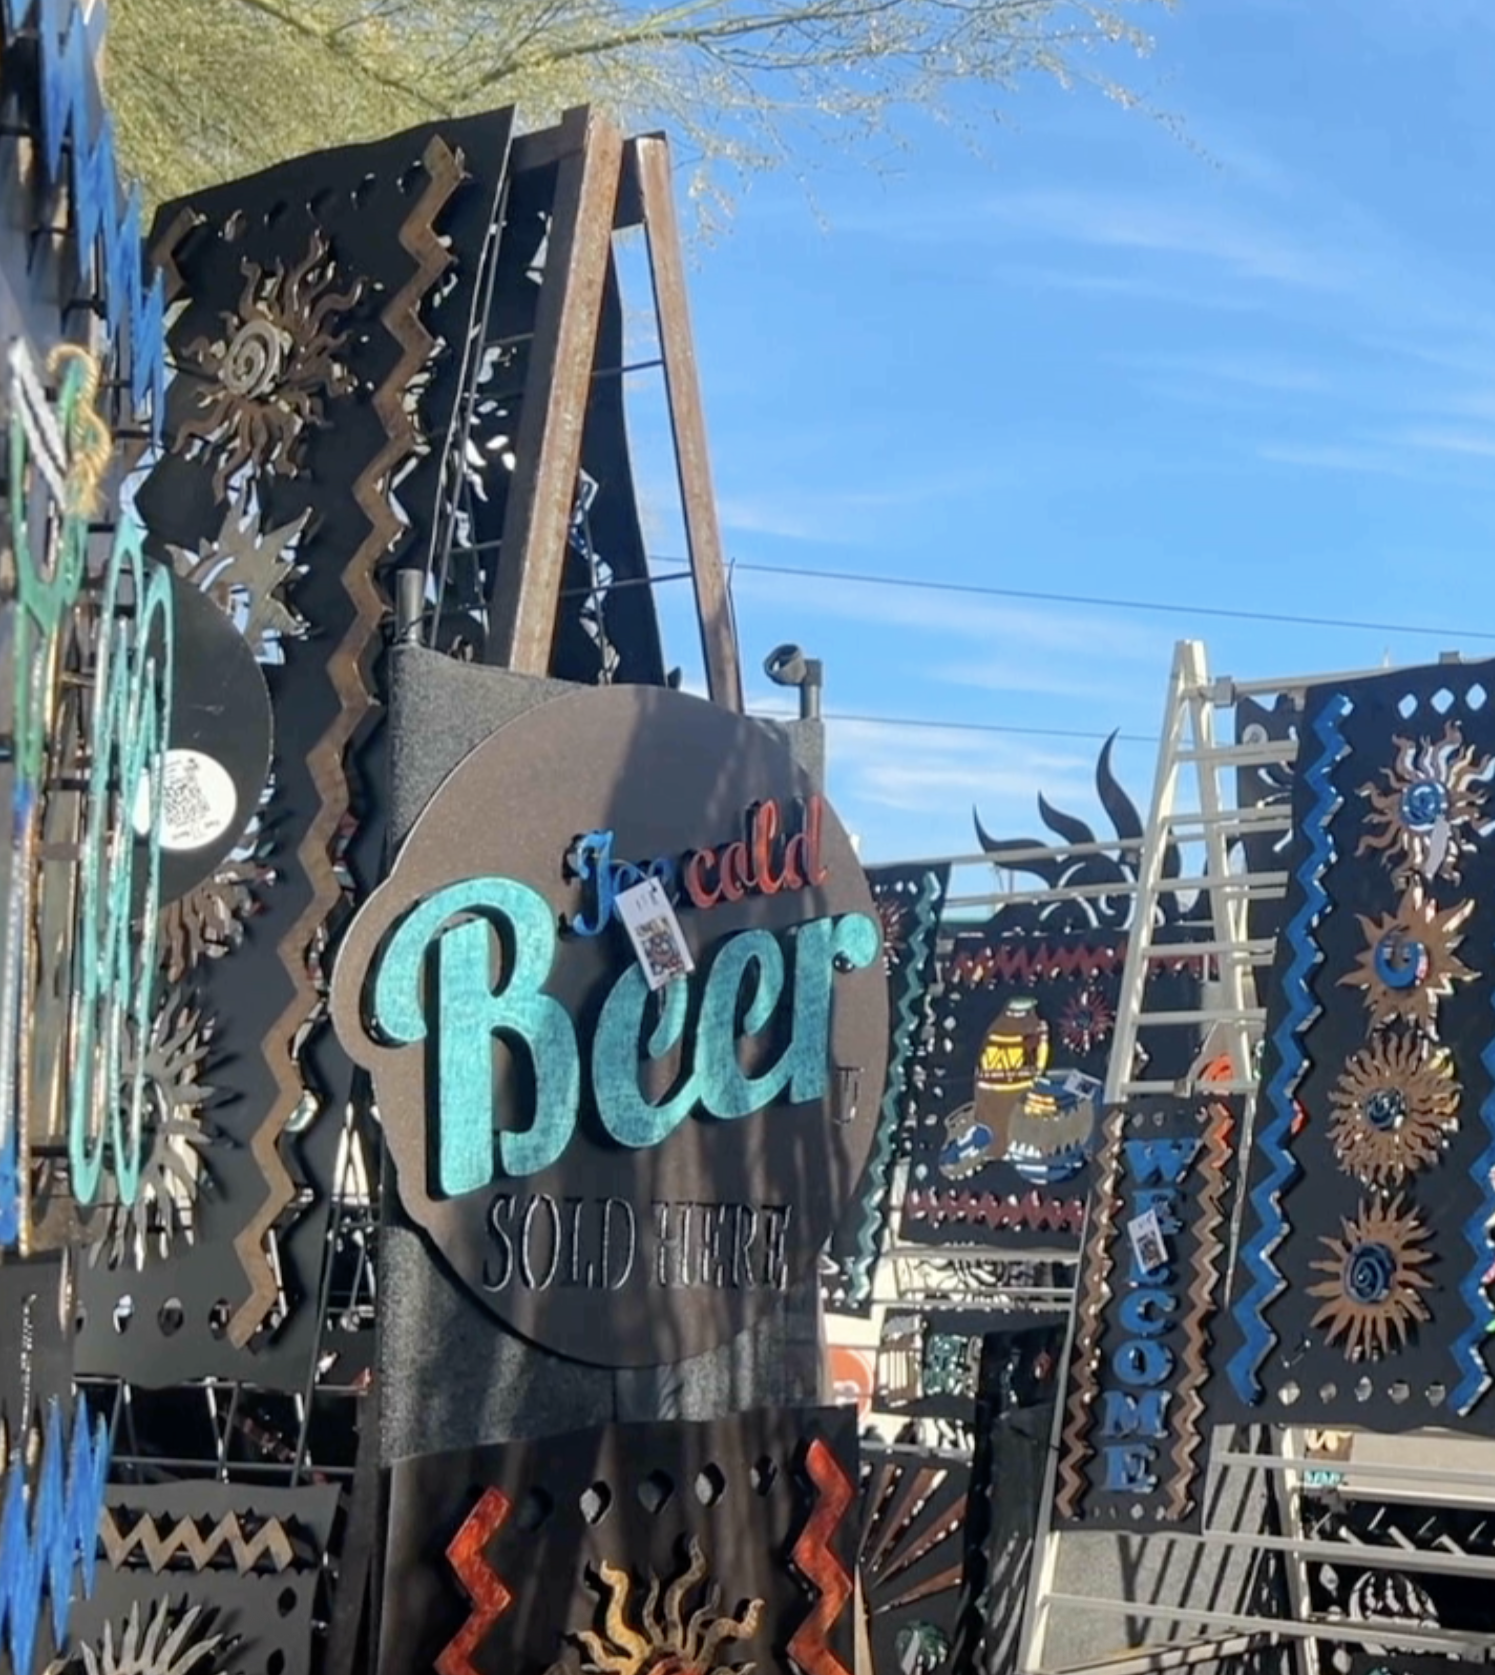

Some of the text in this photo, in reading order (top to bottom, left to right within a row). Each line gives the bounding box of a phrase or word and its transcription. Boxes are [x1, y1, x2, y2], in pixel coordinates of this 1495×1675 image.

[685, 795, 828, 909] cold
[374, 875, 881, 1195] Beer
[483, 1194, 792, 1292] SOLD HERE
